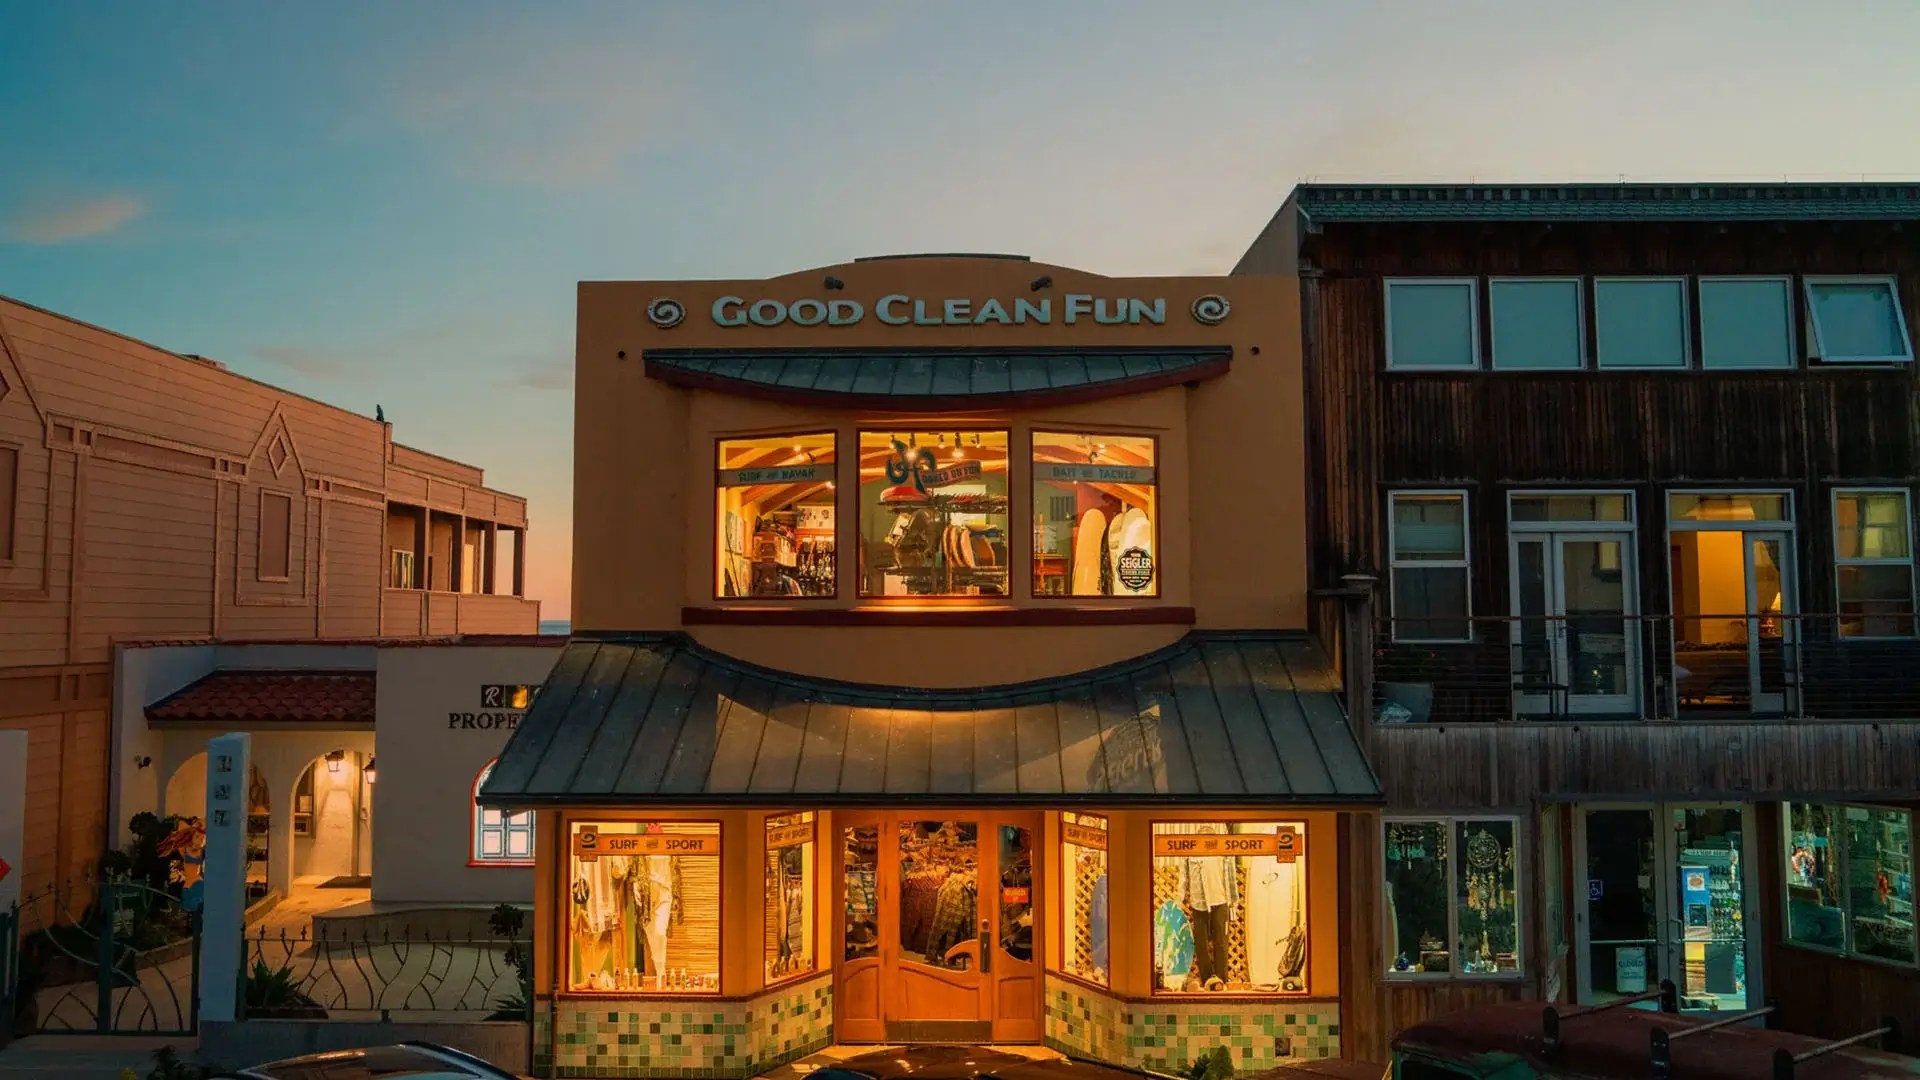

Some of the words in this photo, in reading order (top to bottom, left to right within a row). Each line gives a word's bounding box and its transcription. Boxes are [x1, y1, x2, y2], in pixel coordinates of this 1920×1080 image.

[712, 295, 865, 326] GOOD
[875, 294, 1051, 325] CLEAN
[1064, 294, 1166, 325] FUN
[1121, 557, 1151, 568] SEIGLER
[448, 712, 521, 729] PROPE
[609, 839, 639, 850] SURF
[665, 839, 704, 850] SPORT
[1167, 840, 1197, 850] SURF
[1225, 840, 1264, 851] SPORT
